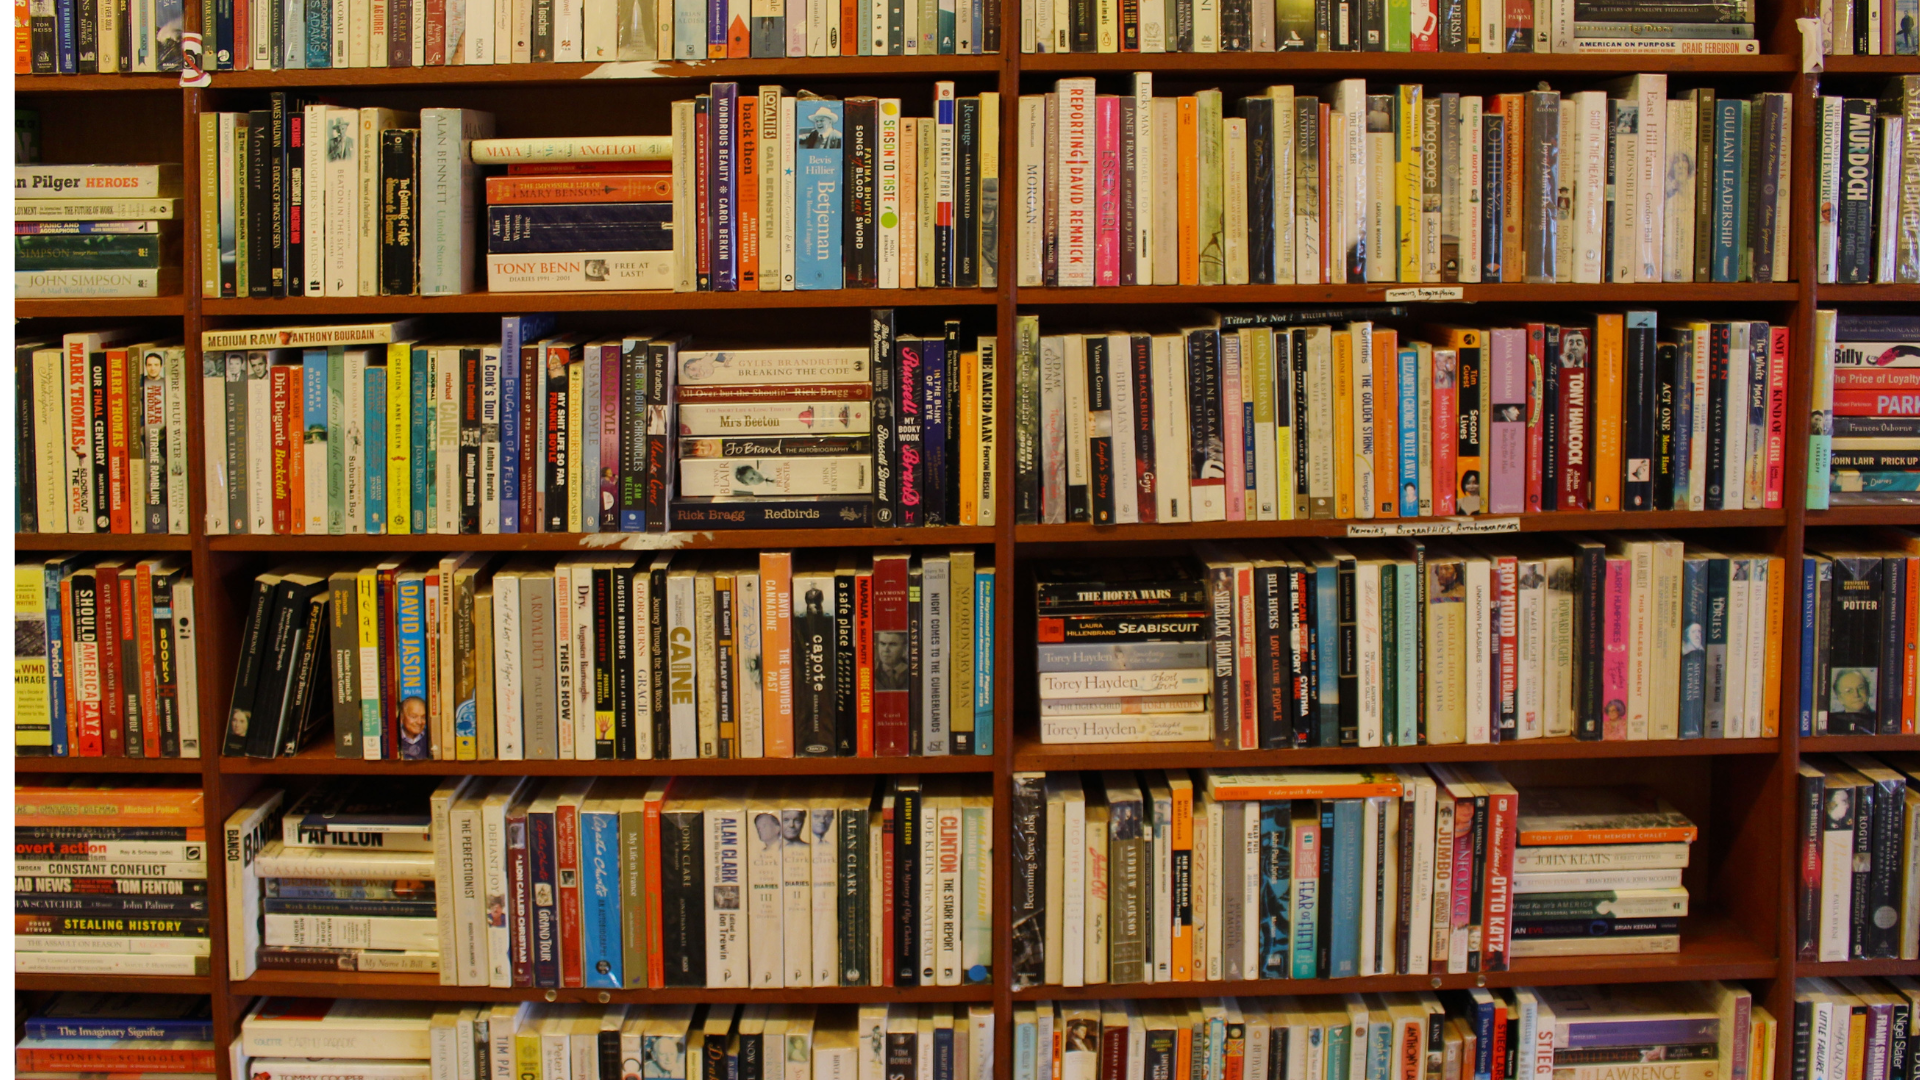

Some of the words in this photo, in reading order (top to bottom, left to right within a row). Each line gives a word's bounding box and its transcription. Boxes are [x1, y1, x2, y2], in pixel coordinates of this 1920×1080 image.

[1682, 43, 1702, 53] CRAIG
[1705, 43, 1739, 53] FERGUSON
[1646, 91, 1657, 117] East
[437, 115, 447, 145] ALAN
[743, 103, 754, 138] back
[1070, 89, 1084, 157] REPORTING
[1646, 123, 1656, 145] Hill
[1723, 106, 1735, 163] GIULIANI
[580, 145, 640, 155] ANGELOU
[744, 141, 754, 175] then
[1645, 149, 1656, 180] Farm
[1847, 114, 1870, 200] MURDOCH
[33, 176, 80, 191] Pilger
[86, 178, 138, 188] HEROES
[437, 150, 447, 204] BENNETT
[1070, 167, 1083, 204] DAVID
[1405, 162, 1420, 191] Life
[1027, 164, 1038, 224] MORGAN
[1408, 196, 1419, 222] List
[1644, 192, 1653, 224] Gordon
[1722, 170, 1734, 247] LEADERSHIP
[337, 206, 344, 215] IN
[812, 180, 835, 261] Betjeman
[436, 210, 446, 242] Untold
[1070, 210, 1083, 264] REMNICK
[1644, 227, 1652, 243] Ball
[436, 245, 446, 277] Stories
[494, 263, 536, 274] TONY
[540, 262, 580, 273] BENN
[29, 275, 67, 288] JOHN
[72, 275, 132, 285] SIMPSON
[293, 331, 334, 343] ANTHONY
[335, 330, 374, 340] BOURDAIN
[70, 342, 84, 385] MARK
[982, 345, 993, 370] THE
[93, 366, 102, 386] OUR
[111, 359, 122, 395] MARK
[274, 372, 285, 398] Dirk
[1362, 374, 1372, 389] THE
[1568, 373, 1584, 406] TONY
[1849, 374, 1873, 384] Price
[1877, 374, 1885, 383] of
[94, 388, 103, 418] FINAL
[982, 372, 993, 413] NAKED
[1362, 392, 1373, 423] GOLDEN
[71, 387, 85, 446] THOMAS
[112, 399, 123, 447] THOMAS
[273, 401, 285, 446] Bogarde
[440, 402, 457, 445] CAINE
[549, 392, 557, 426] FRANKIE
[720, 416, 742, 427] Mrs
[745, 415, 779, 426] Beeton
[982, 415, 992, 443] MAN
[1363, 427, 1373, 455] STRING
[1460, 415, 1468, 439] Lives
[1470, 410, 1478, 444] Second
[1568, 408, 1583, 465] HANCOCK
[95, 420, 105, 466] CENTURY
[548, 428, 556, 463] BOYLE
[275, 449, 287, 499] Backcloth
[1881, 457, 1906, 465] PRICK
[1907, 457, 1918, 465] UP
[625, 476, 633, 505] WELLER
[1140, 472, 1153, 493] Goya
[764, 509, 819, 519] Redbirds
[1501, 563, 1515, 593] ROY
[401, 586, 419, 634] DAVID
[575, 585, 589, 609] Dry.
[766, 580, 776, 631] CANNADINE
[1844, 601, 1878, 610] POTTER
[51, 615, 60, 639] Blue
[80, 590, 95, 641] SHOULD
[1119, 624, 1199, 633] SEABISCUIT
[1215, 591, 1230, 637] SHERLOCK
[1501, 595, 1515, 637] HUDD
[51, 640, 62, 677] Period
[83, 644, 97, 698] AMERICA
[403, 638, 421, 688] JASON
[561, 644, 570, 673] THIS
[811, 635, 826, 691] capote
[1216, 641, 1232, 677] HOLMES
[561, 676, 569, 687] IS
[768, 671, 778, 692] PAST
[1045, 677, 1080, 692] Torey
[1085, 676, 1138, 689] Hayden
[1300, 676, 1308, 716] CYNTHIA
[85, 702, 99, 736] PAY?
[561, 690, 570, 720] HOW
[1044, 722, 1080, 739] Torey
[1083, 722, 1137, 735] Hayden
[462, 819, 471, 834] THE
[721, 818, 737, 845] ALAN
[1858, 816, 1868, 852] ROGUE
[227, 829, 240, 861] BANCO
[488, 824, 498, 869] DEFIANT
[940, 817, 958, 873] CLINTON
[1437, 828, 1452, 880] JUMBO
[462, 836, 474, 899] PERFECTIONIST
[722, 849, 738, 883] CLARK
[1128, 845, 1136, 888] ANDREW
[36, 878, 71, 892] NEWS
[489, 873, 499, 892] JOY
[944, 878, 954, 893] THE
[1298, 881, 1314, 909] FEAR
[1491, 877, 1507, 913] OTTO
[944, 895, 954, 919] STARR
[1128, 893, 1137, 936] JACKSON
[1301, 912, 1310, 920] OF
[64, 920, 123, 930] STEALING
[129, 921, 181, 931] HISTORY
[538, 909, 551, 939] GRAND
[944, 922, 954, 951] REPORT
[1297, 922, 1314, 951] FIFTY
[1489, 917, 1505, 952] KATZ
[540, 940, 552, 961] TOUR
[57, 1026, 77, 1036] The
[79, 1027, 125, 1038] Imaginary
[128, 1028, 164, 1038] Signifier
[1819, 1010, 1827, 1037] LITTLE
[1893, 1013, 1908, 1038] Nigel
[1537, 1032, 1553, 1074] STIEG
[1816, 1039, 1826, 1073] FAILURE
[1893, 1041, 1906, 1069] Slater
